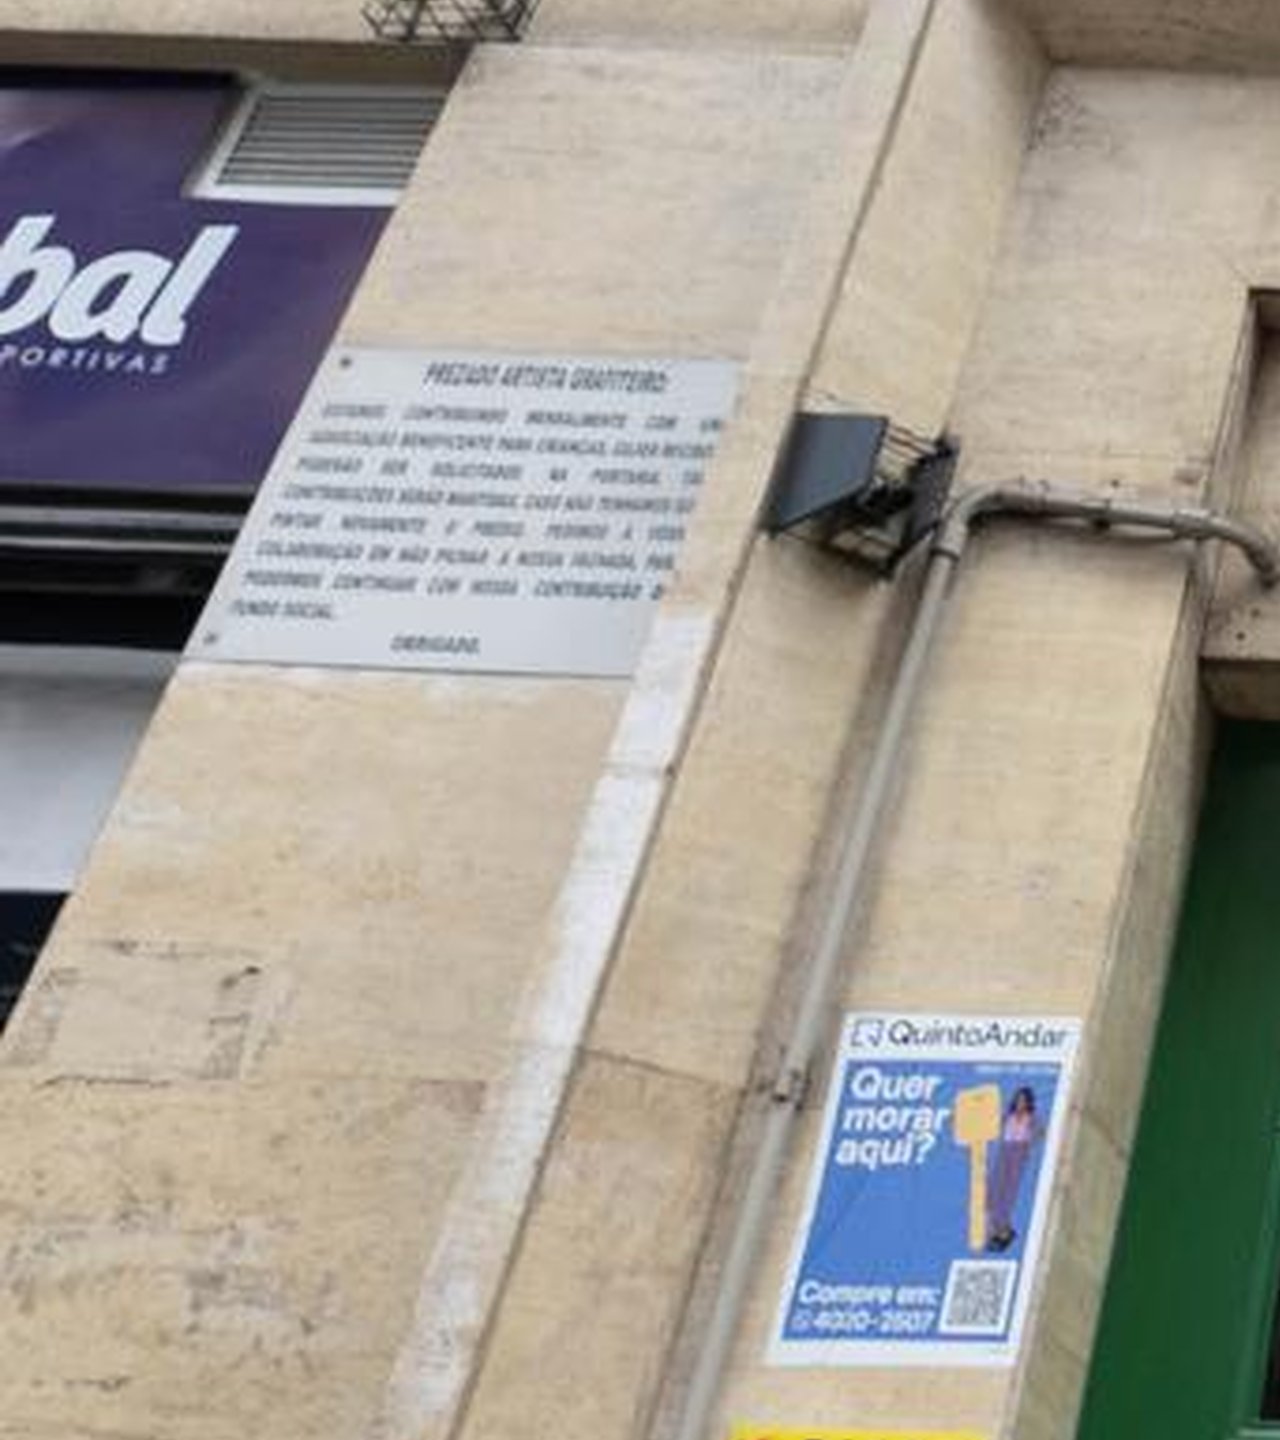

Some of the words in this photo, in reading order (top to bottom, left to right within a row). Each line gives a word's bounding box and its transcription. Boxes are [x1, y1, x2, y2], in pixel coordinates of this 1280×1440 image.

[888, 1019, 1067, 1048] QuintoAndar
[851, 1066, 943, 1100] Quer
[842, 1105, 951, 1133] morar
[834, 1131, 936, 1170] aqui?
[799, 1279, 894, 1308] Compre
